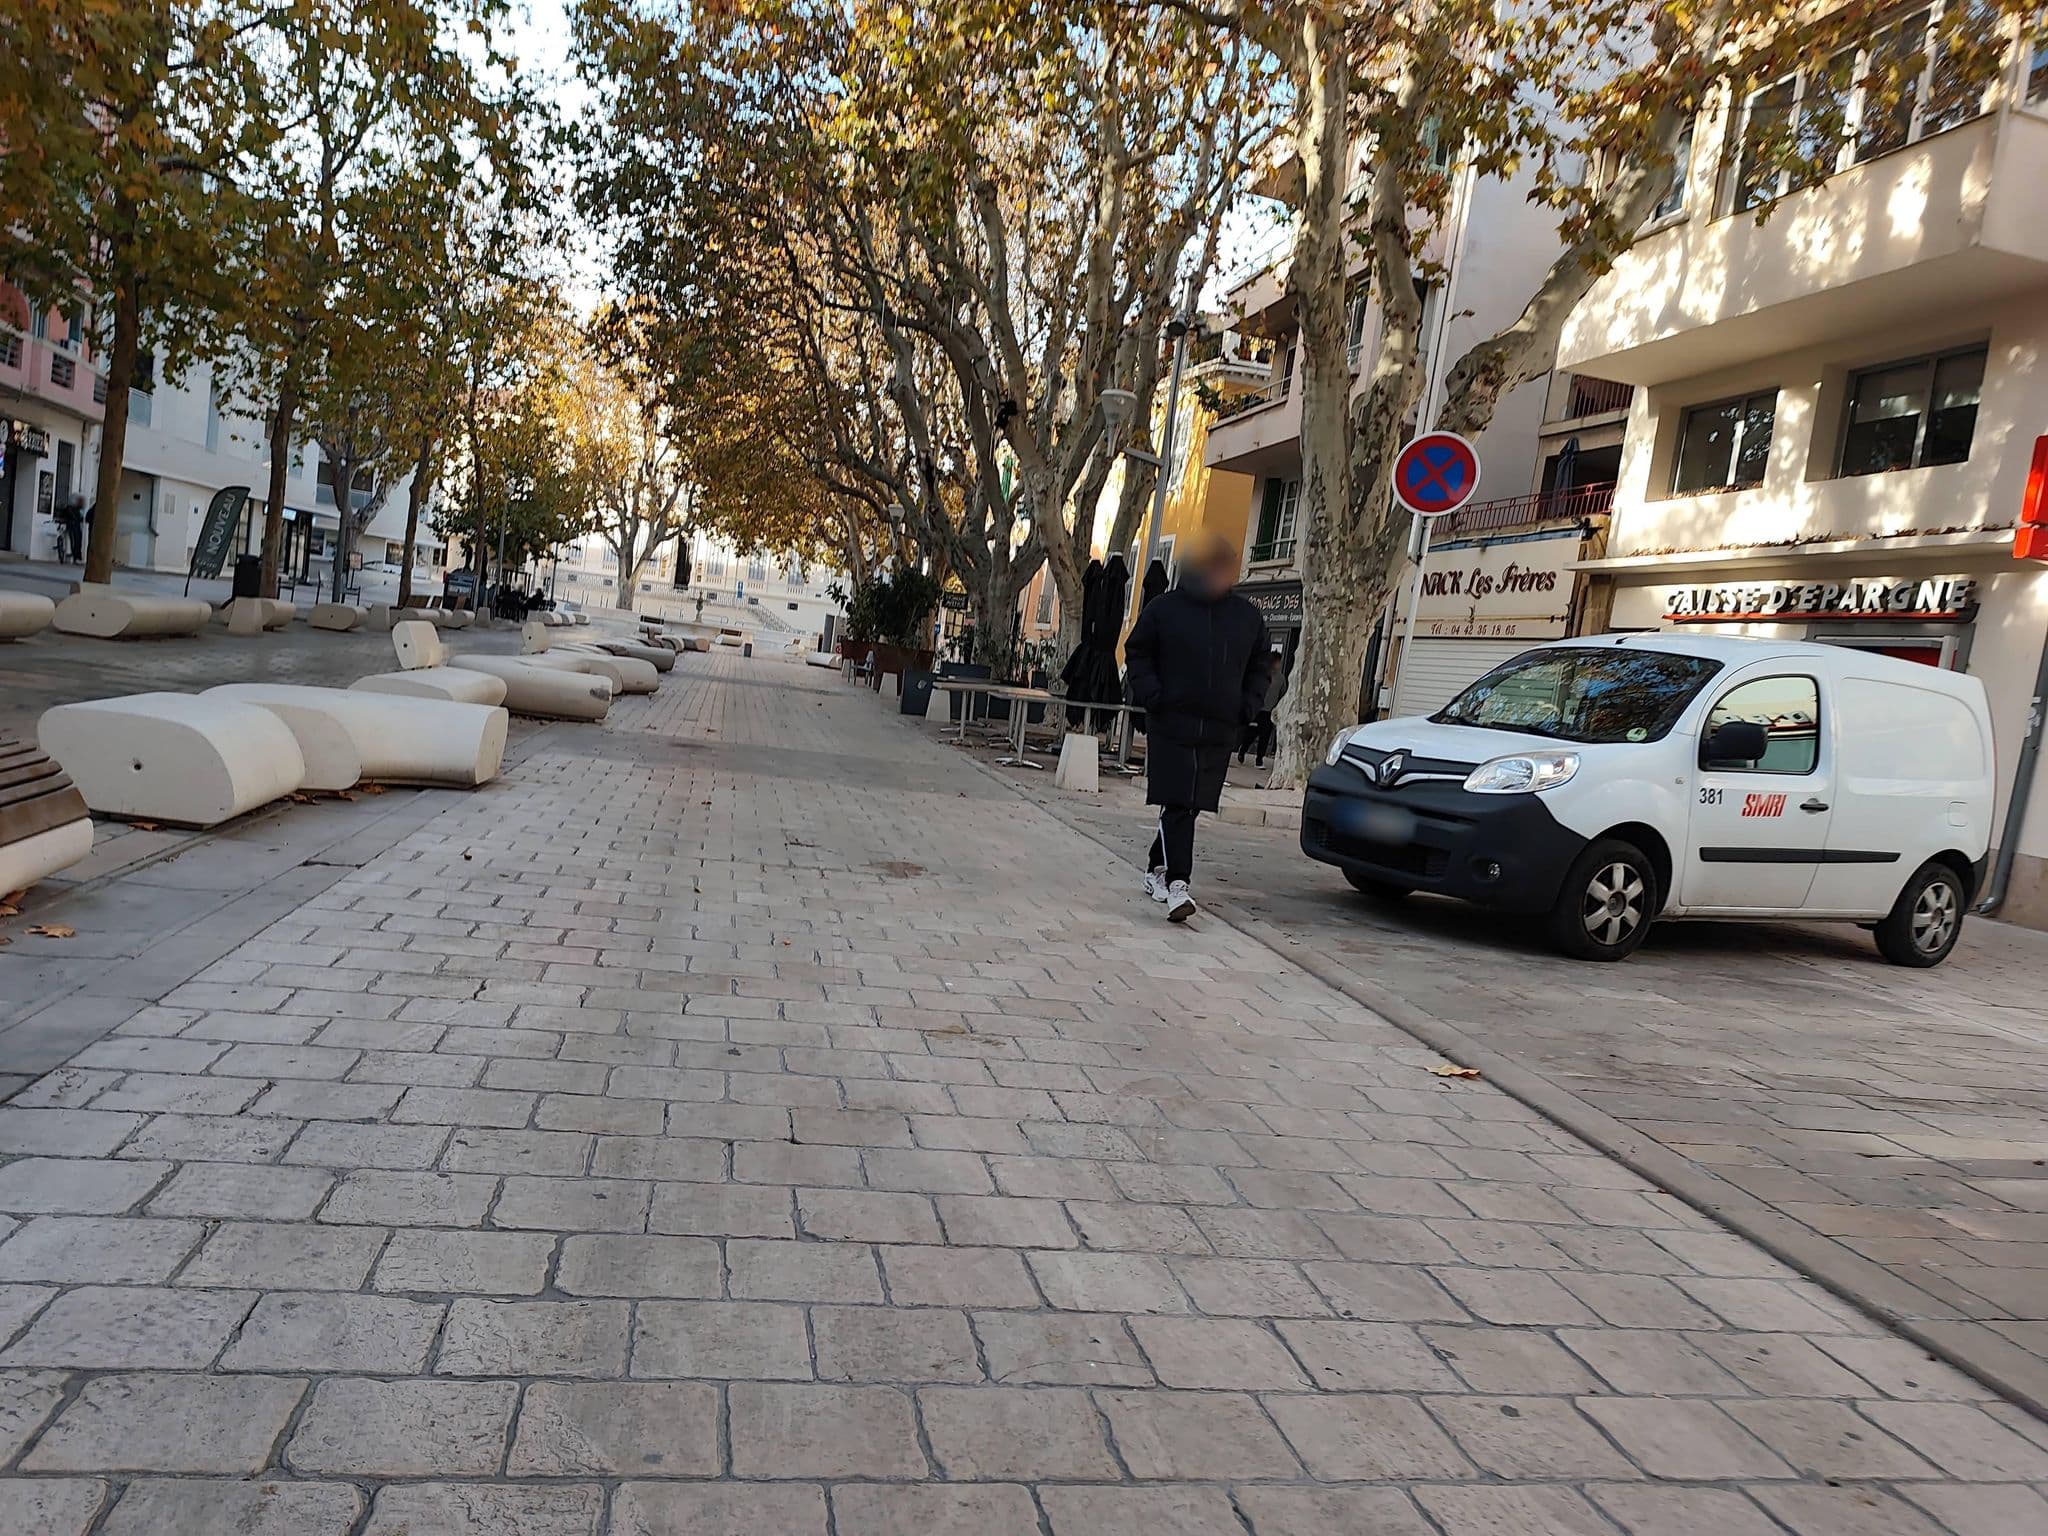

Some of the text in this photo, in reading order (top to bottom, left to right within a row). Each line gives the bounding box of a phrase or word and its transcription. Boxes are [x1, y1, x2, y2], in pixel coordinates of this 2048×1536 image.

[206, 493, 236, 556] NOUVEAU
[1411, 561, 1557, 599] NACK Les Frères
[1664, 585, 1760, 614] CAISSE
[1451, 624, 1460, 635] 04
[1464, 624, 1474, 635] 42
[1477, 624, 1487, 635] 35
[1491, 624, 1501, 635] 18
[1699, 788, 1723, 805] 381
